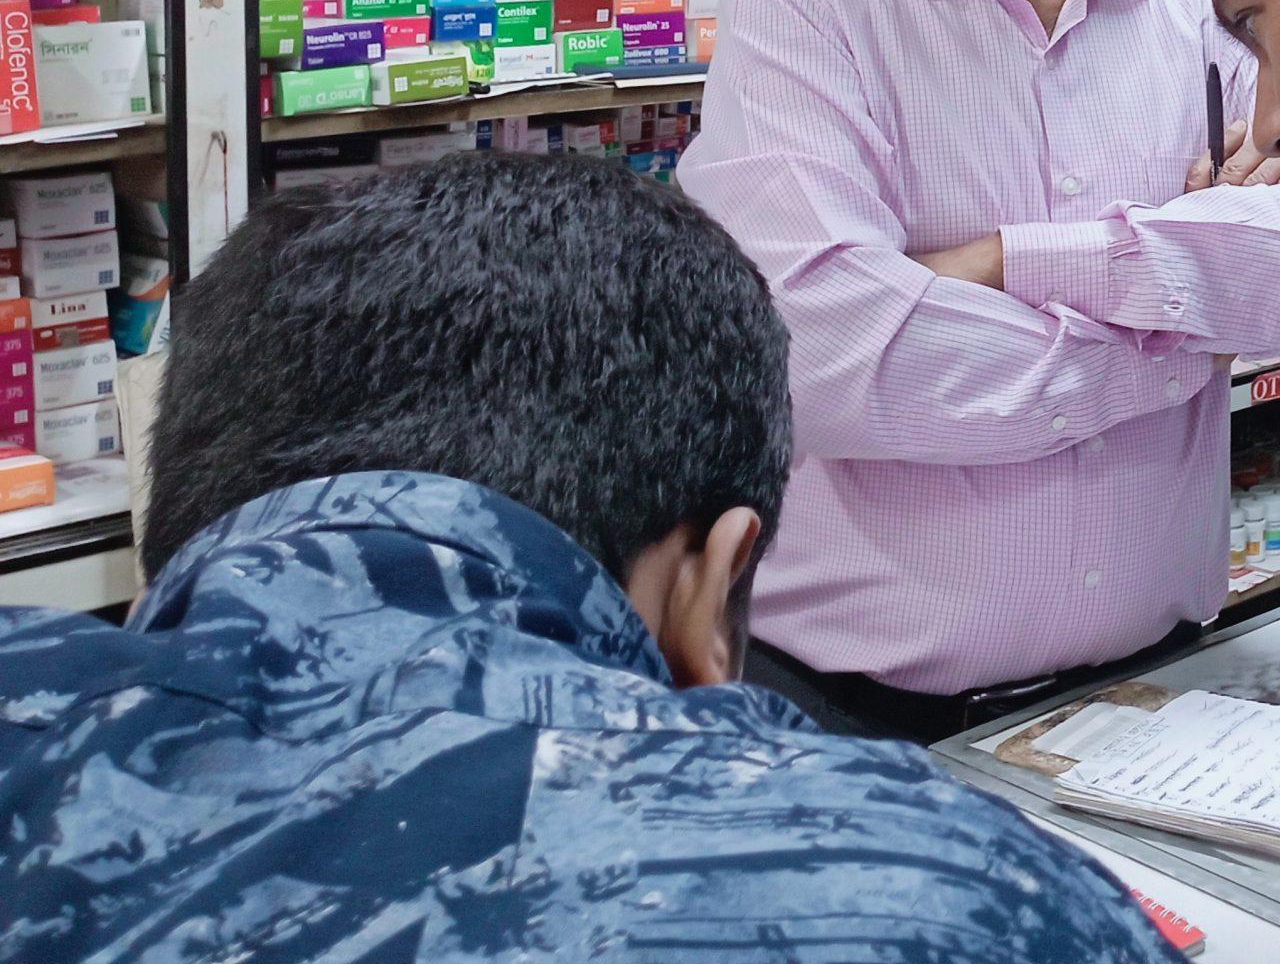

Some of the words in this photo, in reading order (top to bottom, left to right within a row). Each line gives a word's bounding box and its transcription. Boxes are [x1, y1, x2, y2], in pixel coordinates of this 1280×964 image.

[497, 6, 538, 19] Contilex
[623, 21, 658, 33] Neurolin
[305, 32, 347, 46] Neurolin
[567, 36, 608, 51] Robic
[5, 10, 33, 112] Clofenac
[37, 185, 85, 200] Moxaclav
[89, 181, 107, 194] 625
[43, 246, 89, 262] Moxaclav
[93, 242, 111, 255] 625
[40, 357, 87, 373] Moxaclav
[92, 352, 110, 365] 625
[43, 414, 89, 432] Moxaclav
[95, 410, 113, 422] 625
